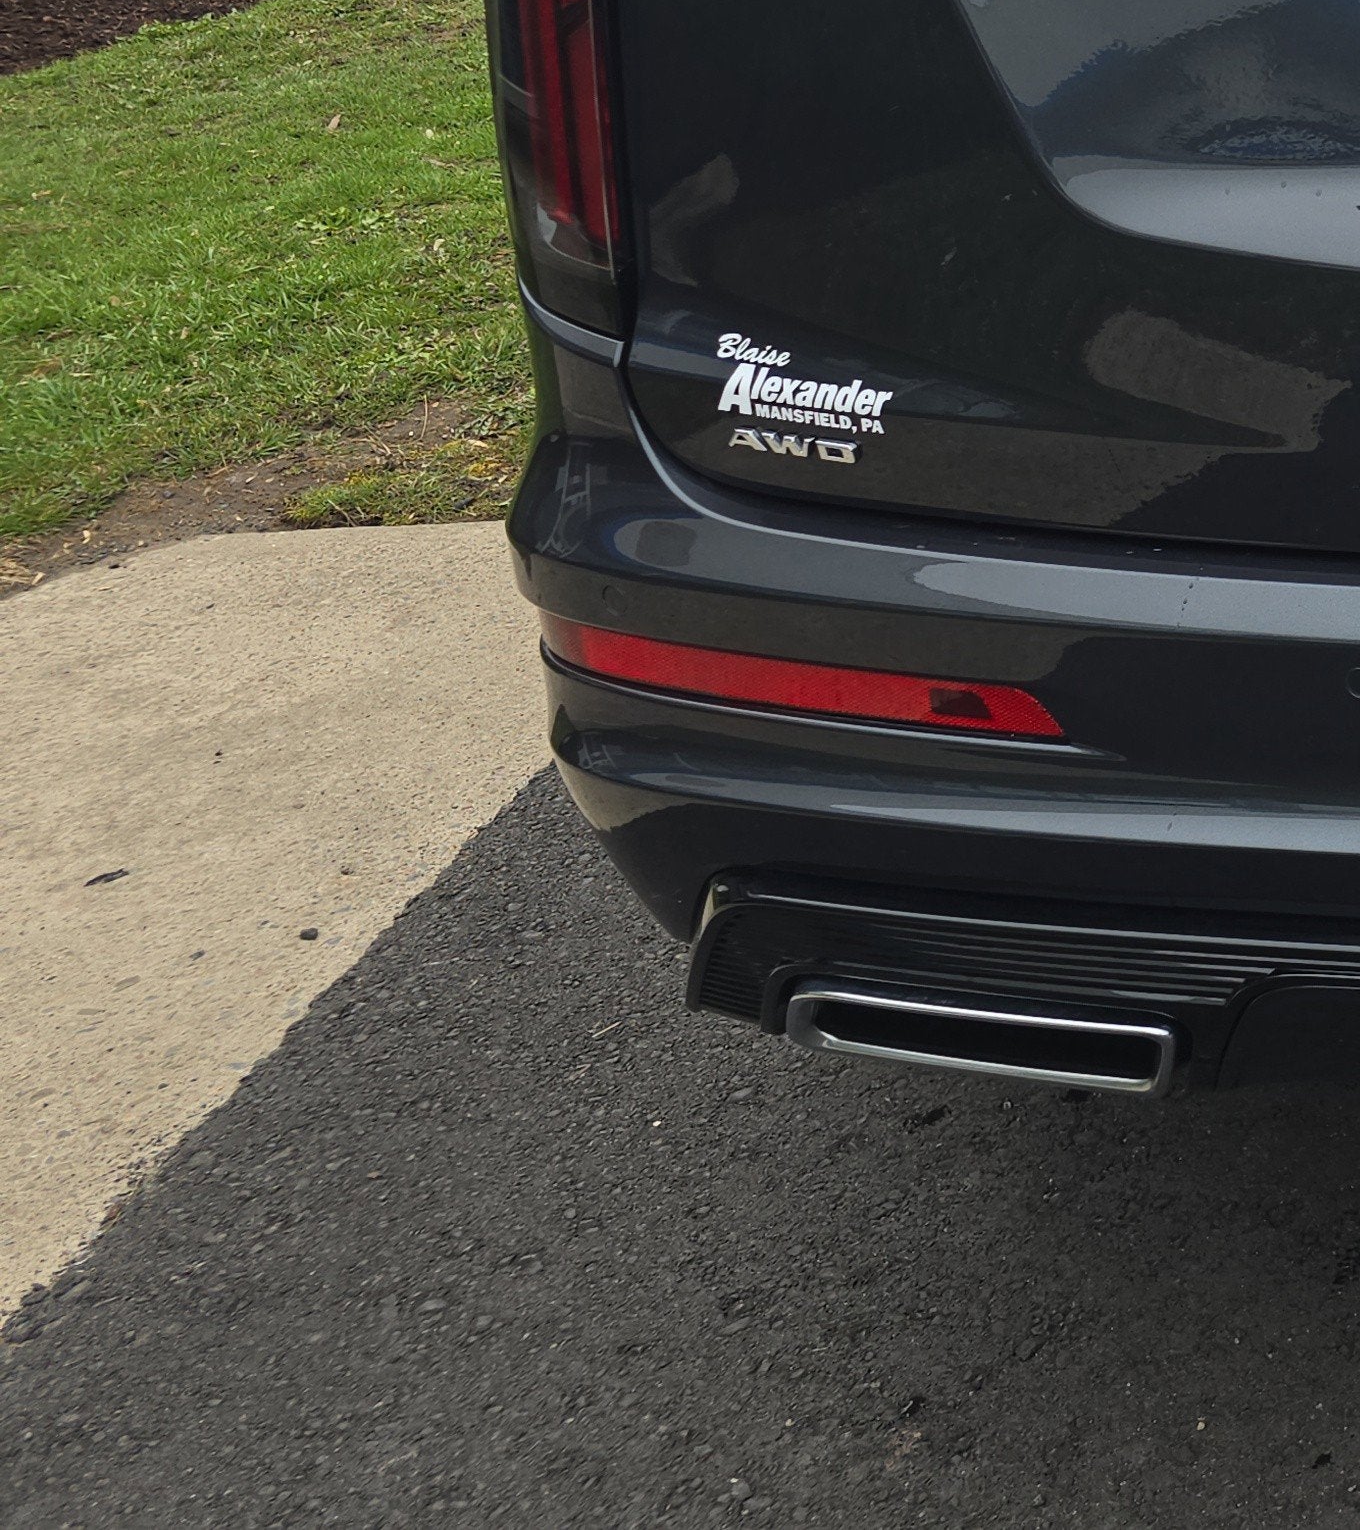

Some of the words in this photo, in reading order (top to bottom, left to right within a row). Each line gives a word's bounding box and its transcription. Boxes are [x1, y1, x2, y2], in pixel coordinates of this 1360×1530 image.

[716, 332, 791, 367] Blaise
[717, 362, 894, 416] Alexander
[754, 403, 858, 434] MANSFIELD,
[861, 420, 885, 435] PA
[728, 427, 862, 464] AWD
